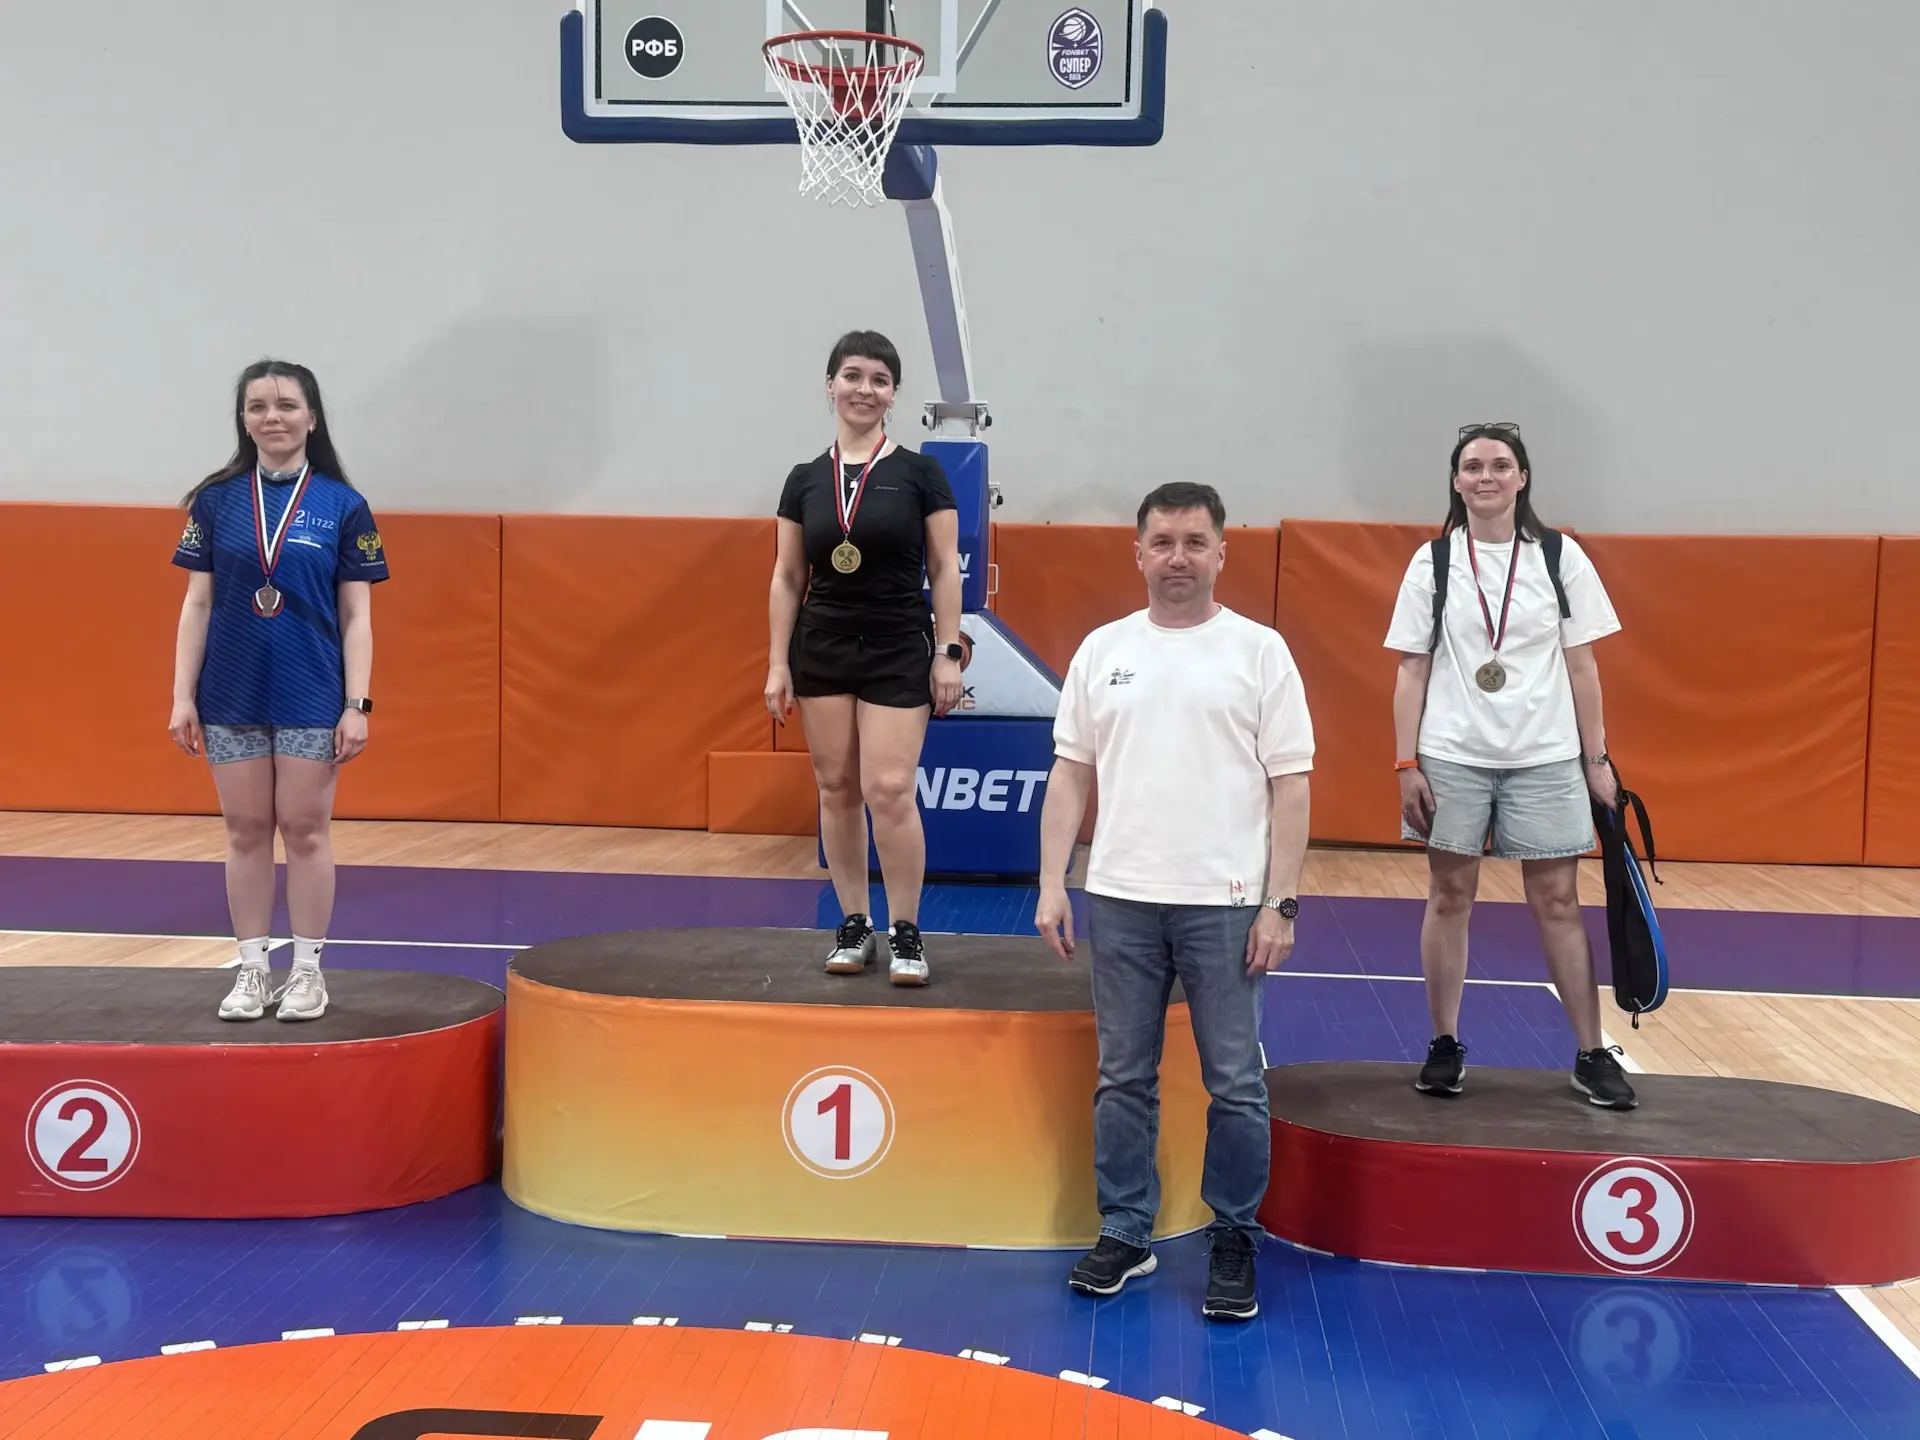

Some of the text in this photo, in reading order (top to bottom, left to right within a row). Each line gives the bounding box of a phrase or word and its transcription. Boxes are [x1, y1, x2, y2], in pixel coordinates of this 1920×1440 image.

[631, 39, 678, 57] РФБ
[1059, 57, 1092, 73] СУПЕР
[311, 517, 335, 530] 1722
[915, 766, 1049, 813] NBET
[56, 1096, 109, 1172] 2
[815, 1084, 851, 1160] 1
[1604, 1176, 1660, 1255] 3
